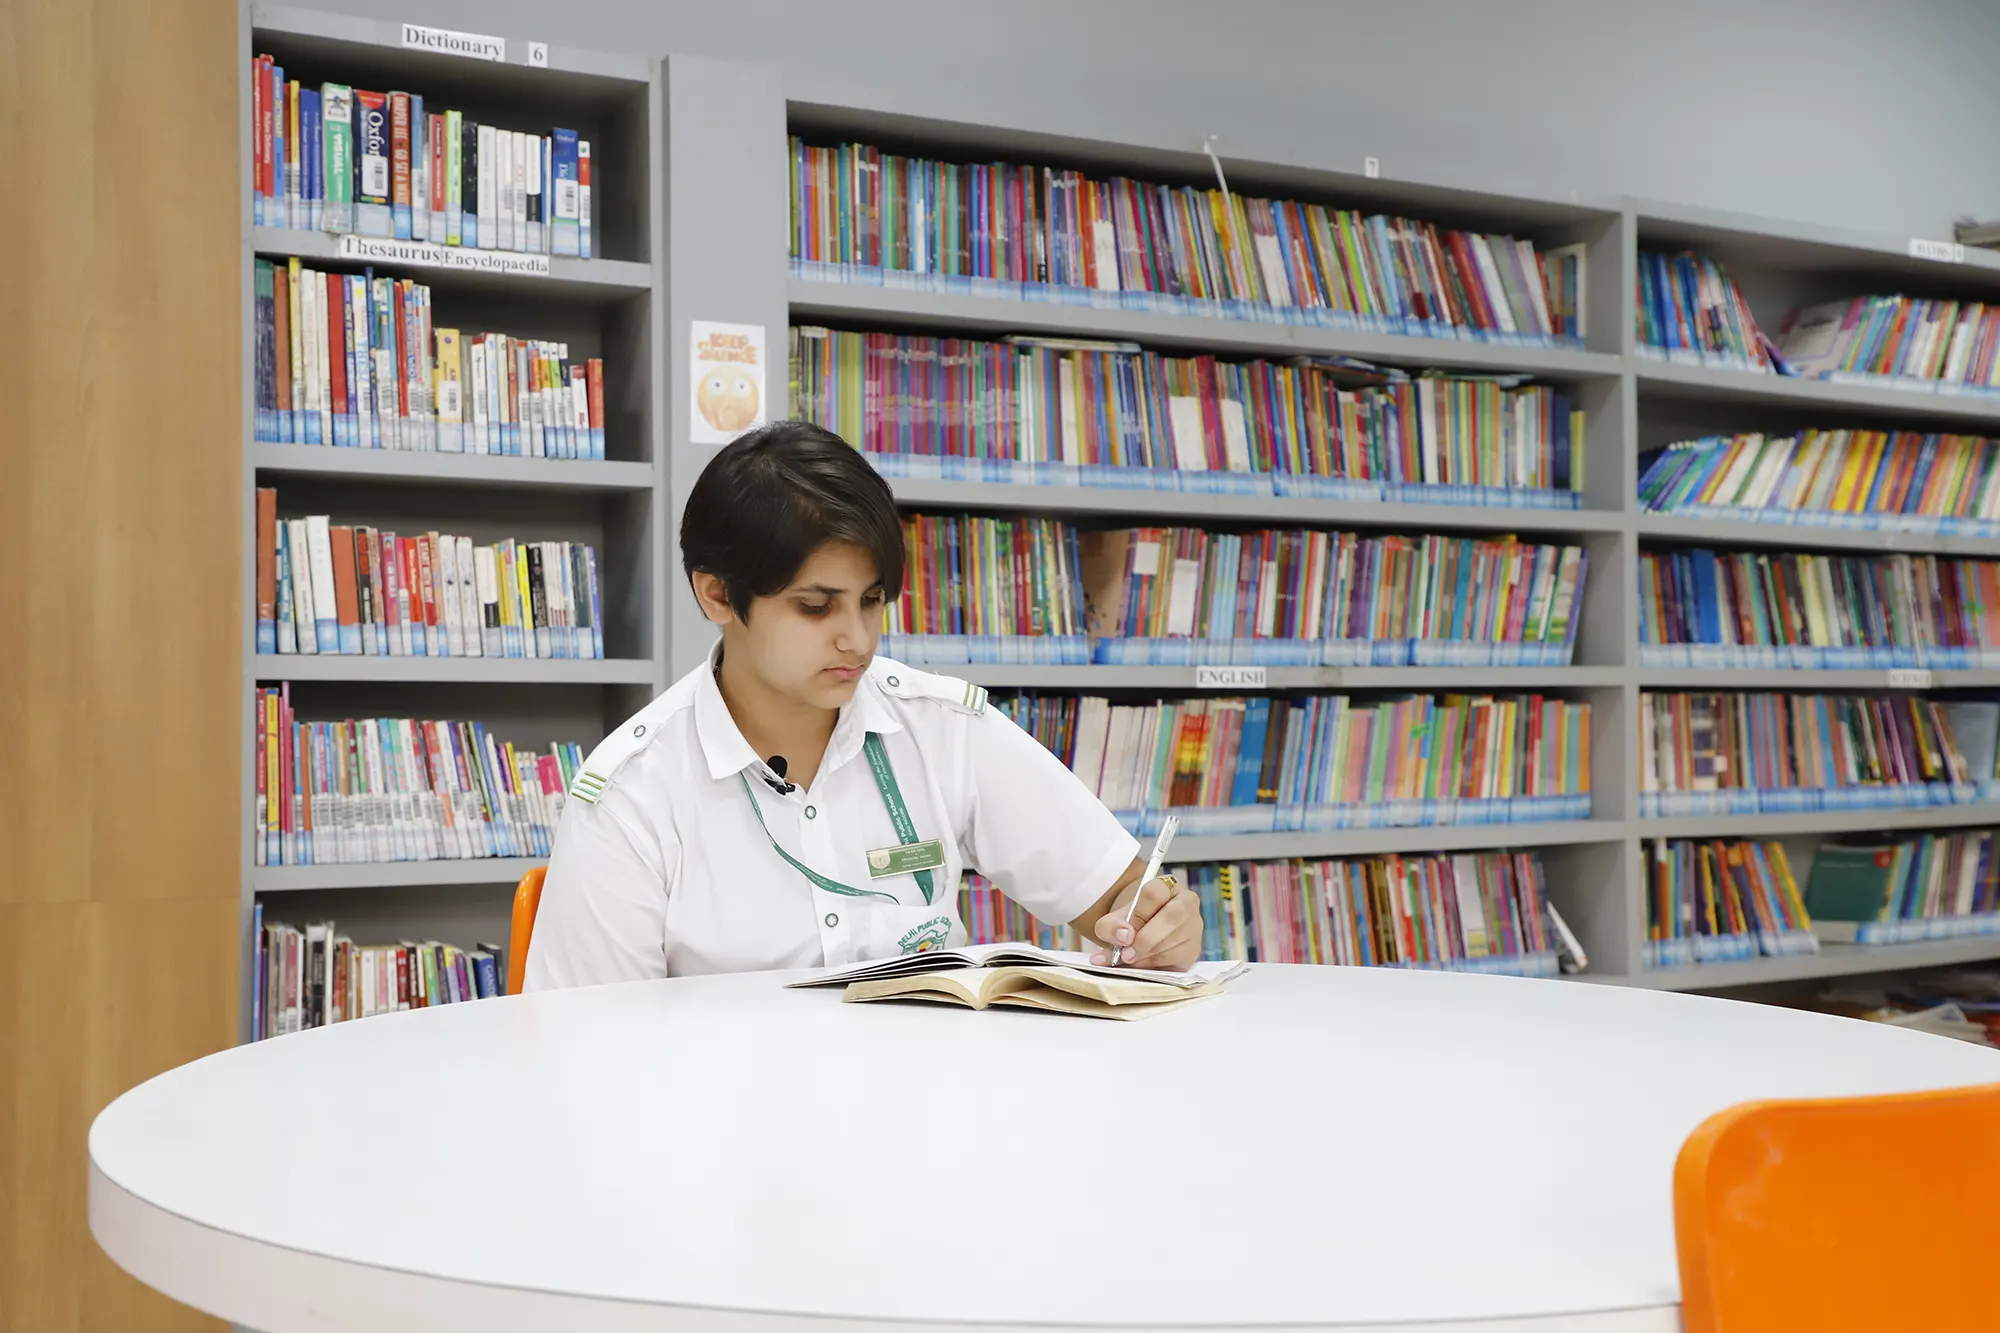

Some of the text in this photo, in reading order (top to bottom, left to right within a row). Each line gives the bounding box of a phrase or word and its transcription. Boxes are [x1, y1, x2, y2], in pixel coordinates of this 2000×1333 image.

[405, 27, 502, 62] Dictionary
[533, 46, 544, 61] 6
[367, 111, 385, 157] Oxfor
[345, 238, 441, 262] Thesaurus
[444, 250, 549, 273] Encyclopaedia
[1198, 670, 1264, 684] ENGLISH
[886, 793, 899, 817] School
[895, 816, 907, 838] Public
[896, 928, 918, 948] DELHI
[917, 916, 940, 933] PUBLIC
